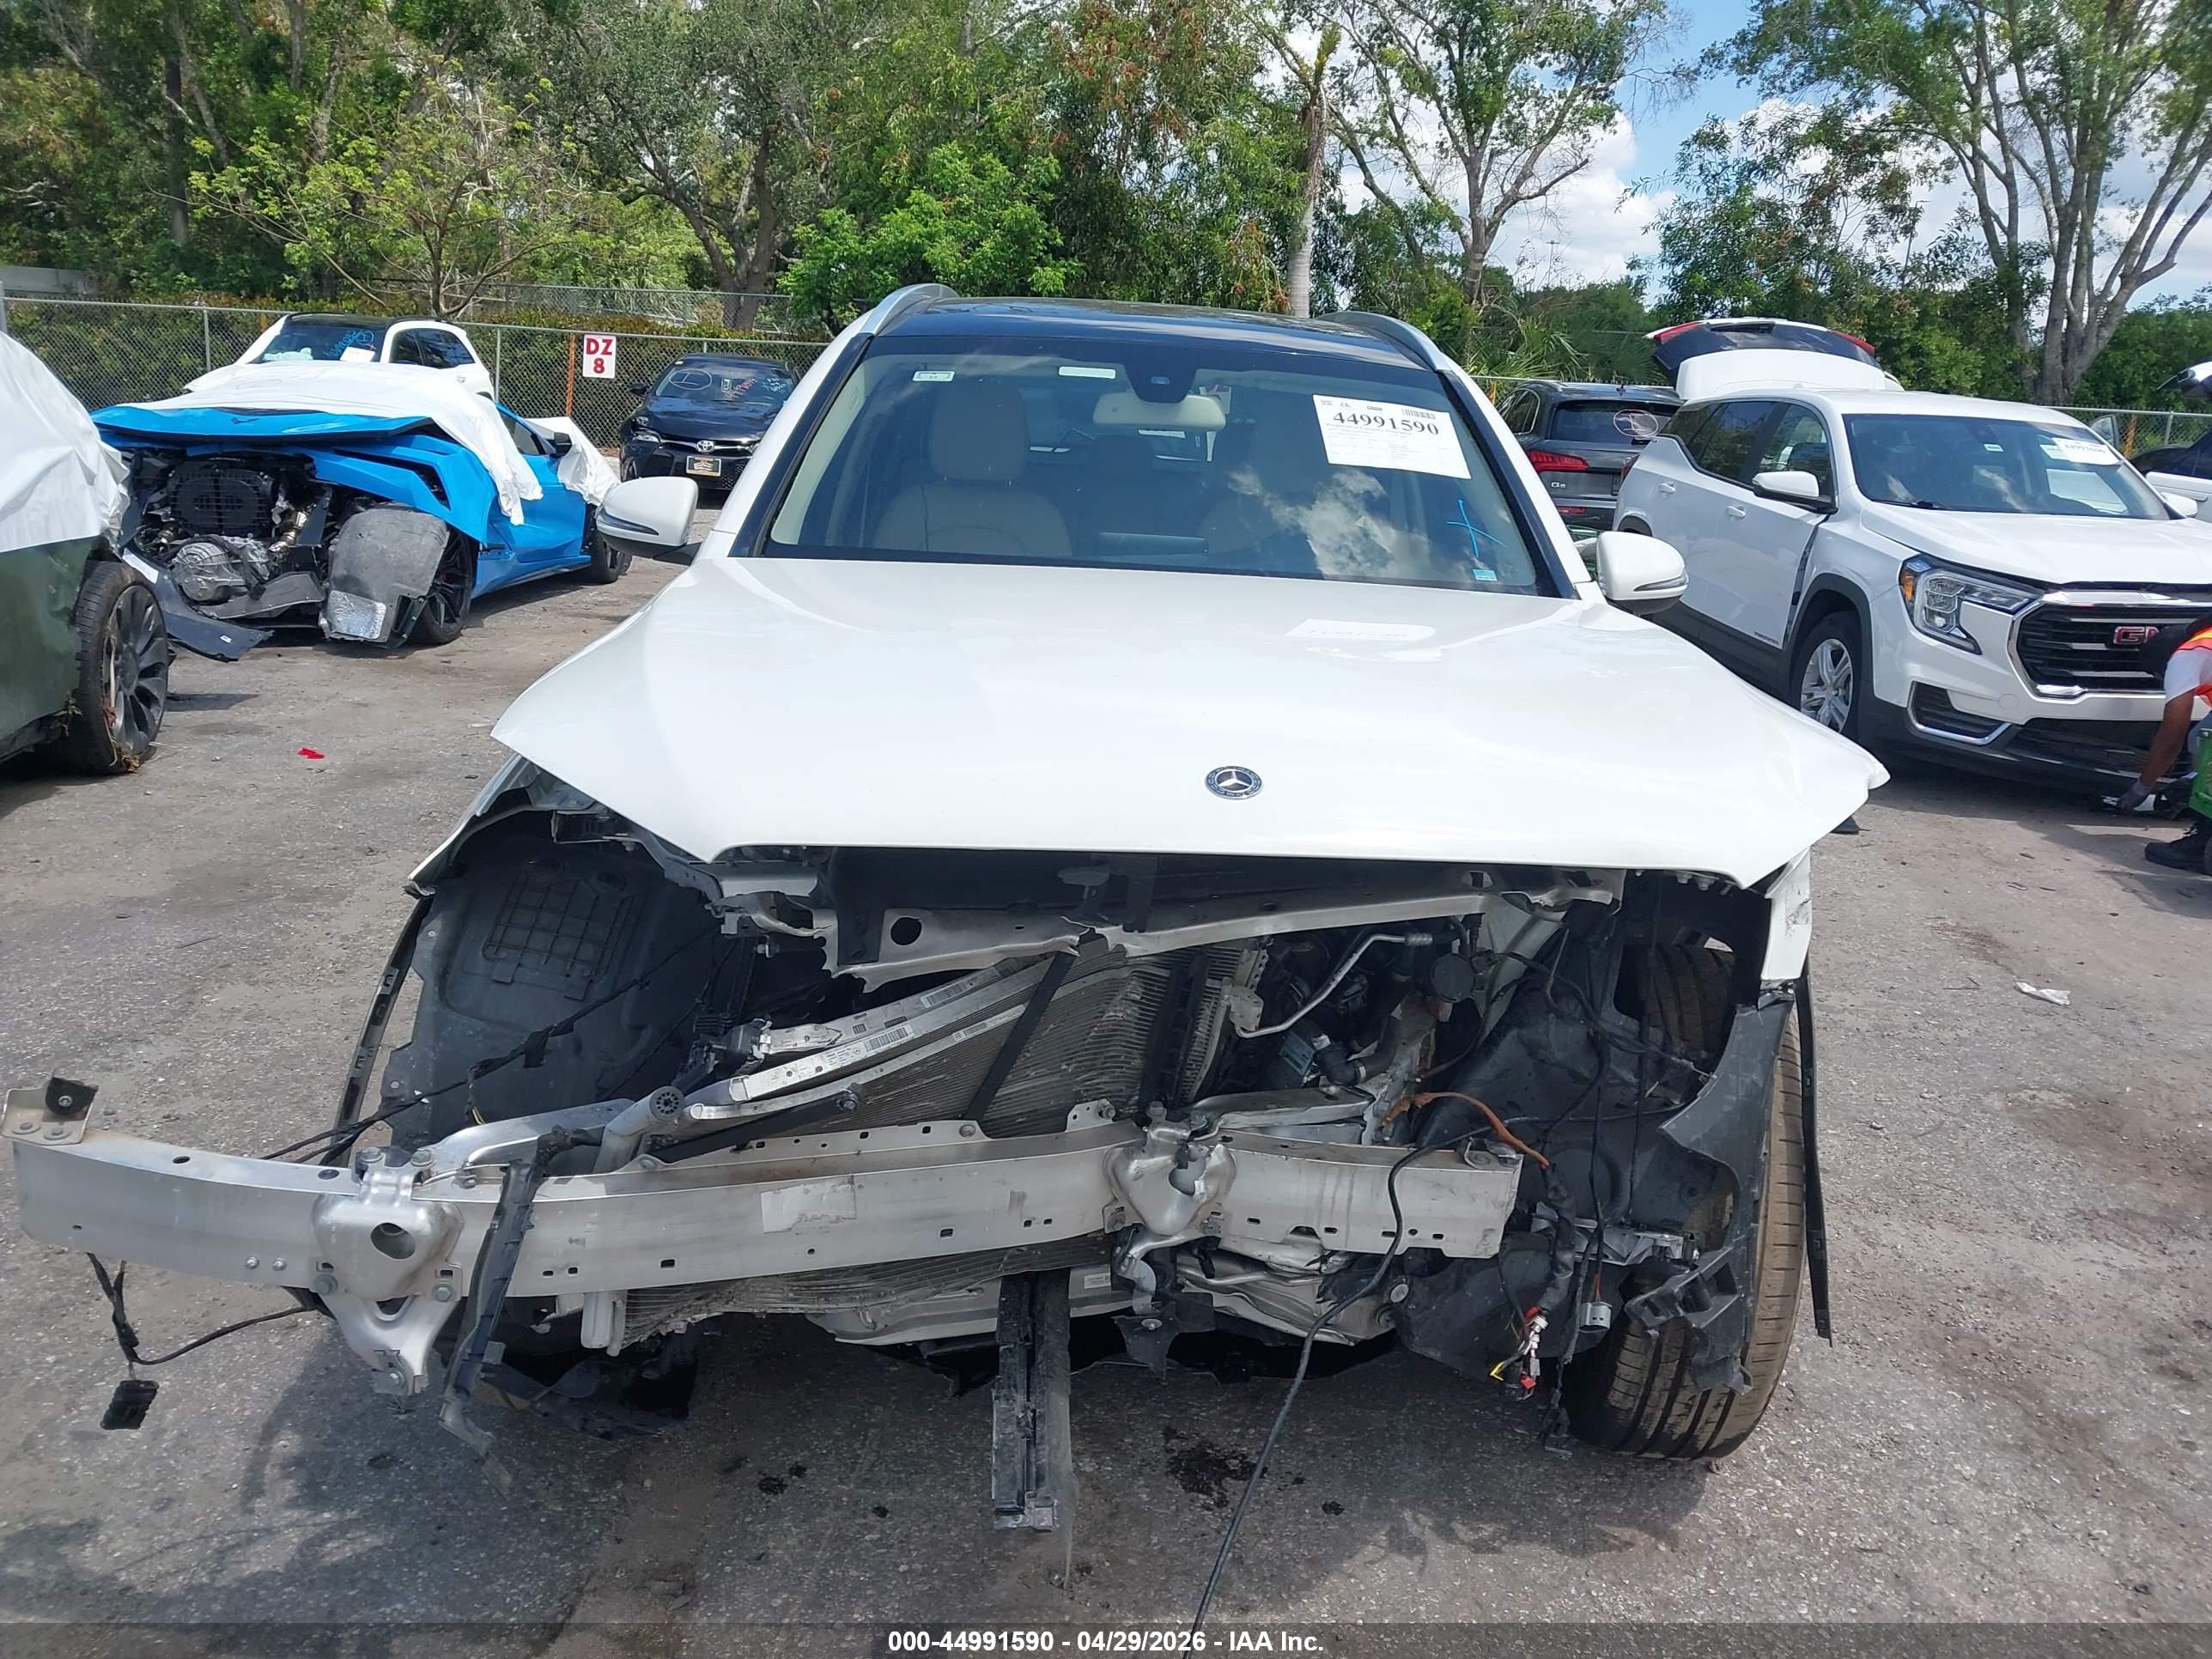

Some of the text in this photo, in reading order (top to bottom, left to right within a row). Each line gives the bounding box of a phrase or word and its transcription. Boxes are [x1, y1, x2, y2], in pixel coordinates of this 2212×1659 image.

[586, 338, 613, 356] DZ
[593, 357, 605, 374] 8
[1333, 412, 1439, 435] 44991590
